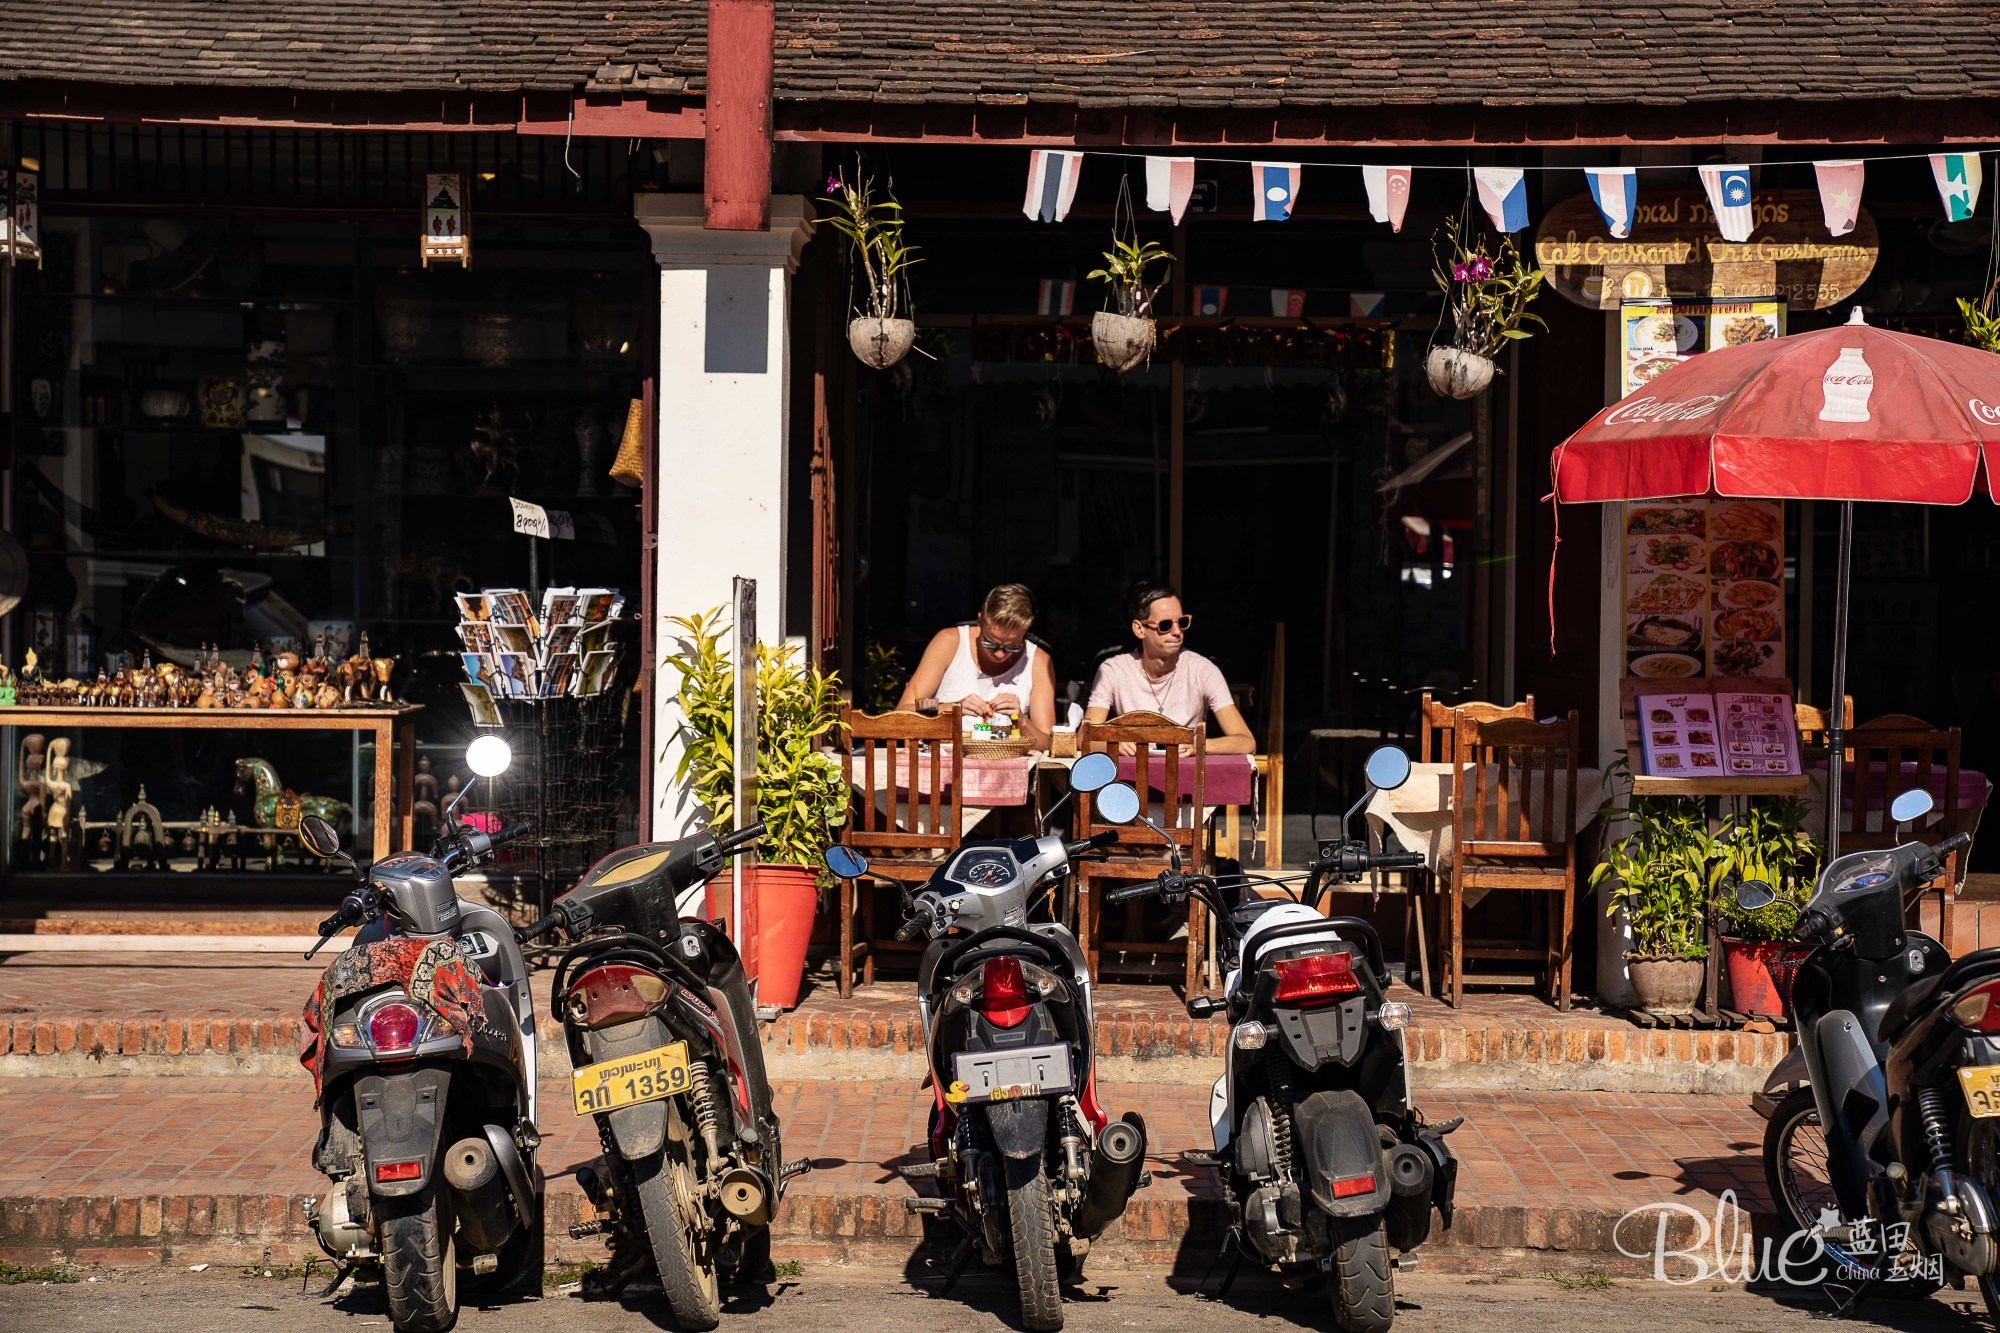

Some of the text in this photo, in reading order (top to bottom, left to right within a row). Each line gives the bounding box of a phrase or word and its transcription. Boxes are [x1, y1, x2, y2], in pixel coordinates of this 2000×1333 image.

[1539, 230, 1582, 280] Café
[1584, 236, 1685, 264] Croissant
[1742, 247, 1753, 262] &
[1756, 236, 1871, 264] Guestrooms
[1300, 948, 1326, 956] HONDA
[624, 1066, 685, 1100] 1359
